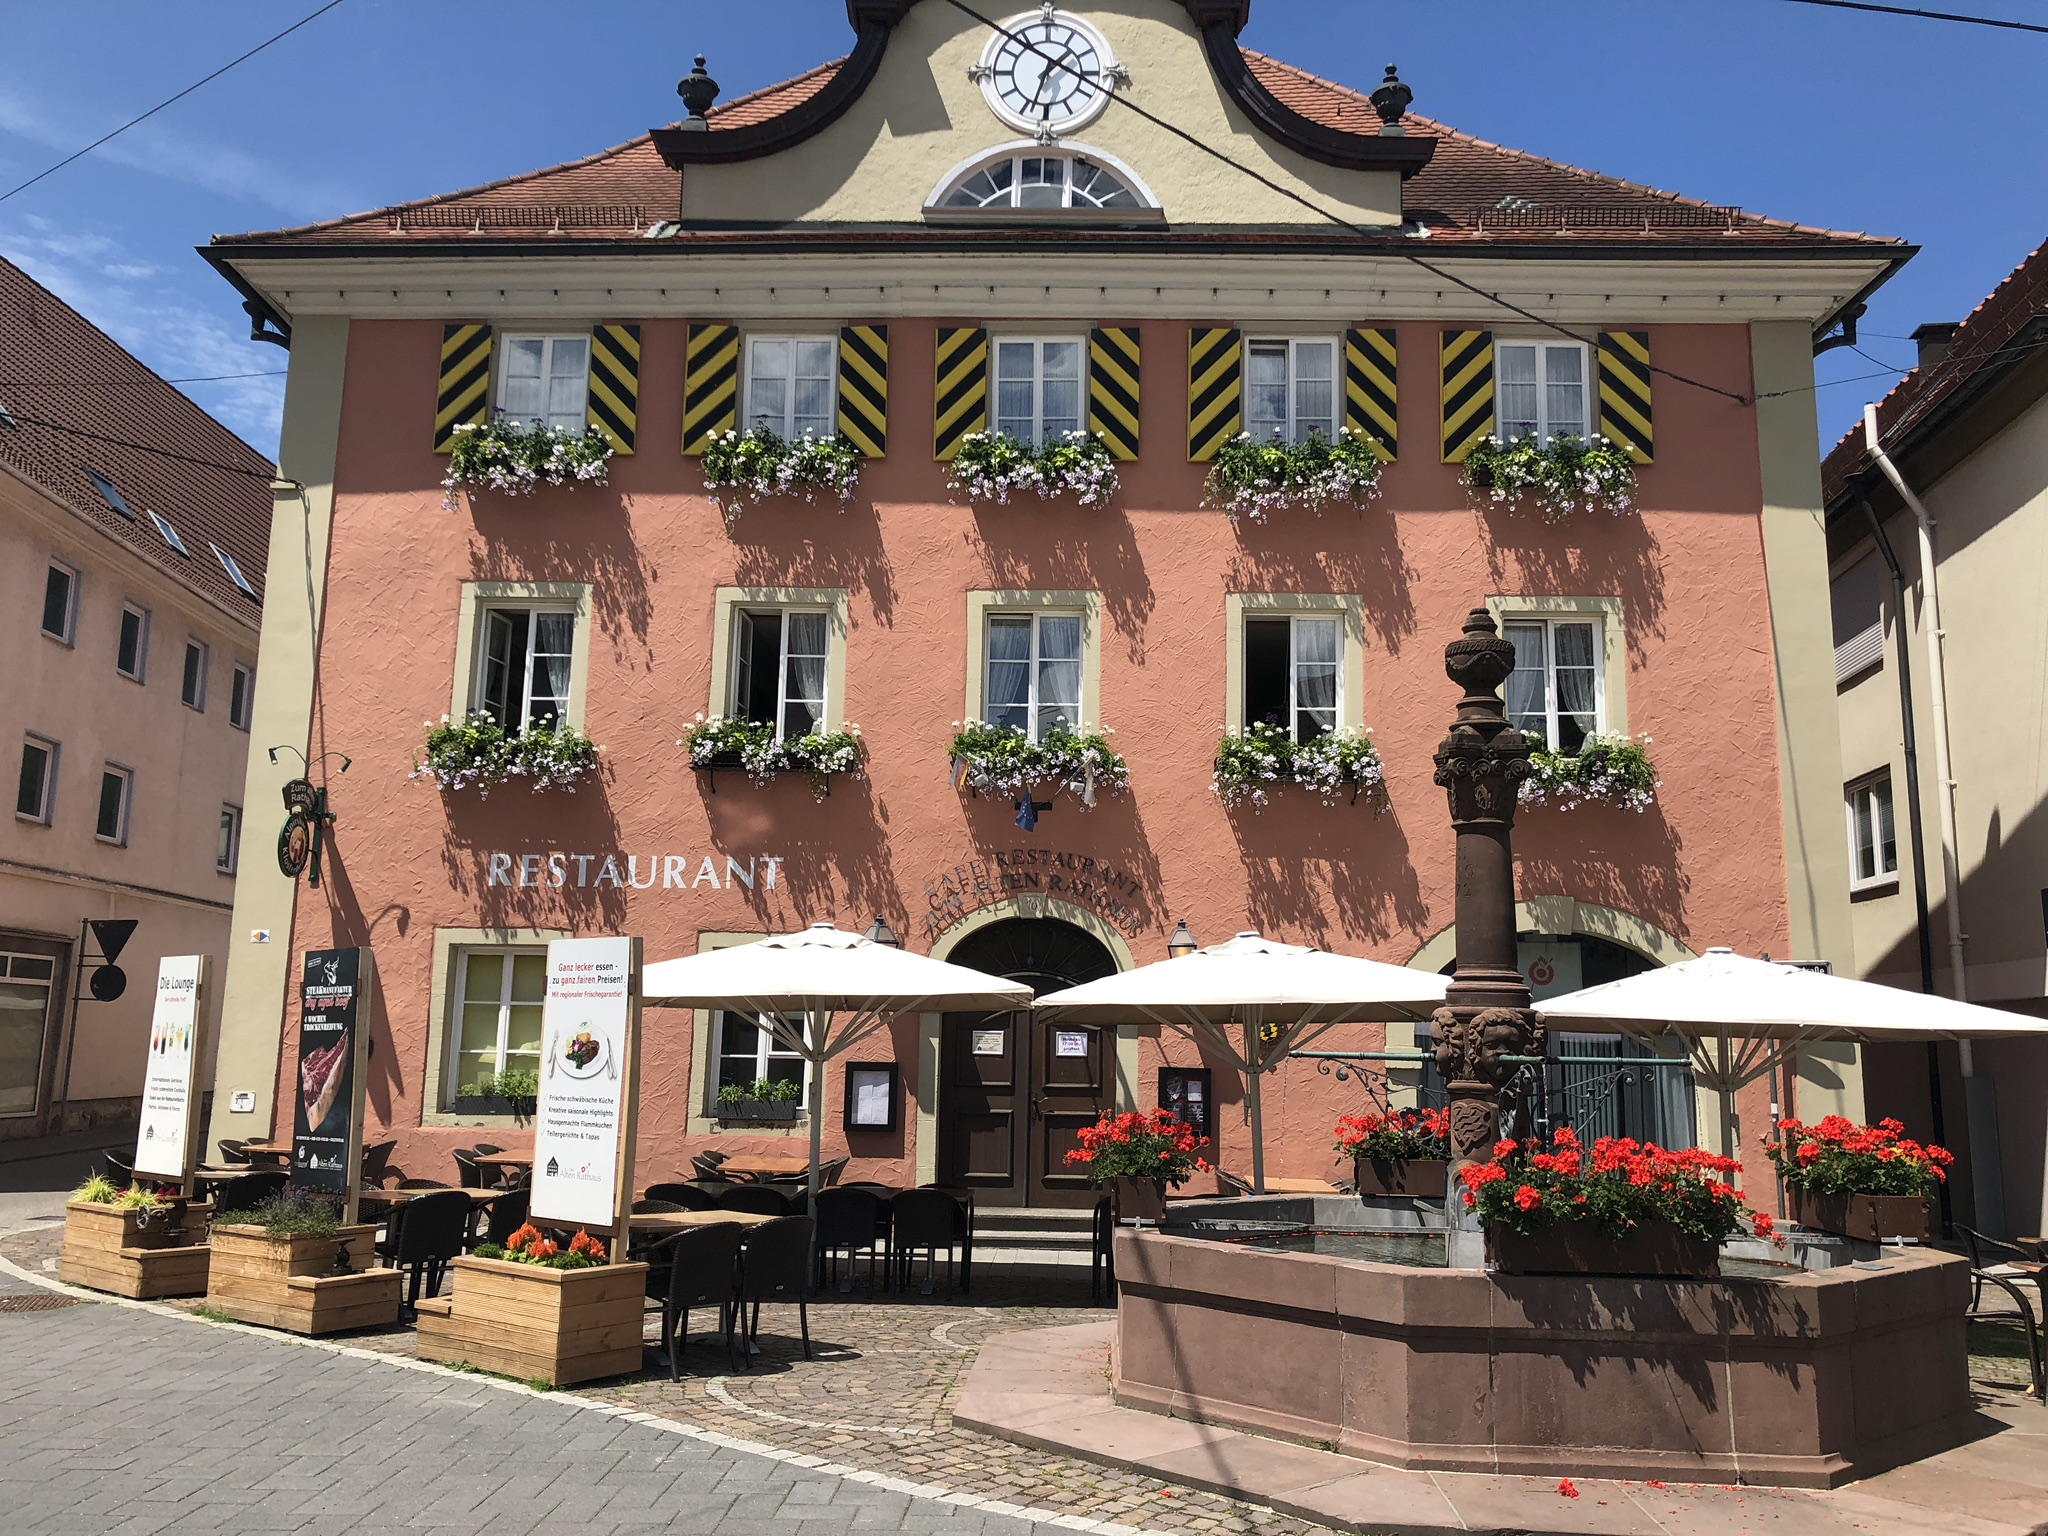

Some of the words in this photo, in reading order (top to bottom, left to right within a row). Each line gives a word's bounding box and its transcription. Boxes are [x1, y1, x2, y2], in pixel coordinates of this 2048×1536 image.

[291, 784, 307, 793] Zum
[488, 853, 784, 890] RESTAURANT
[995, 849, 1143, 898] RESTAURANT
[558, 963, 573, 972] Ganz
[575, 963, 594, 971] lecker
[595, 963, 613, 971] essen
[160, 976, 170, 990] Die
[171, 976, 194, 992] Lounge
[561, 976, 575, 986] ganz
[576, 975, 595, 984] fairen
[597, 975, 623, 984] Preisen!
[560, 991, 583, 999] regionaler
[584, 991, 622, 999] Frischegarantie!
[590, 1108, 613, 1117] Highlights
[580, 1120, 612, 1129] Flammkuchen
[547, 1130, 579, 1139] Tellergerichte
[585, 1133, 599, 1141] Tapas
[560, 1168, 575, 1179] Alten
[577, 1169, 601, 1181] Rathaus
